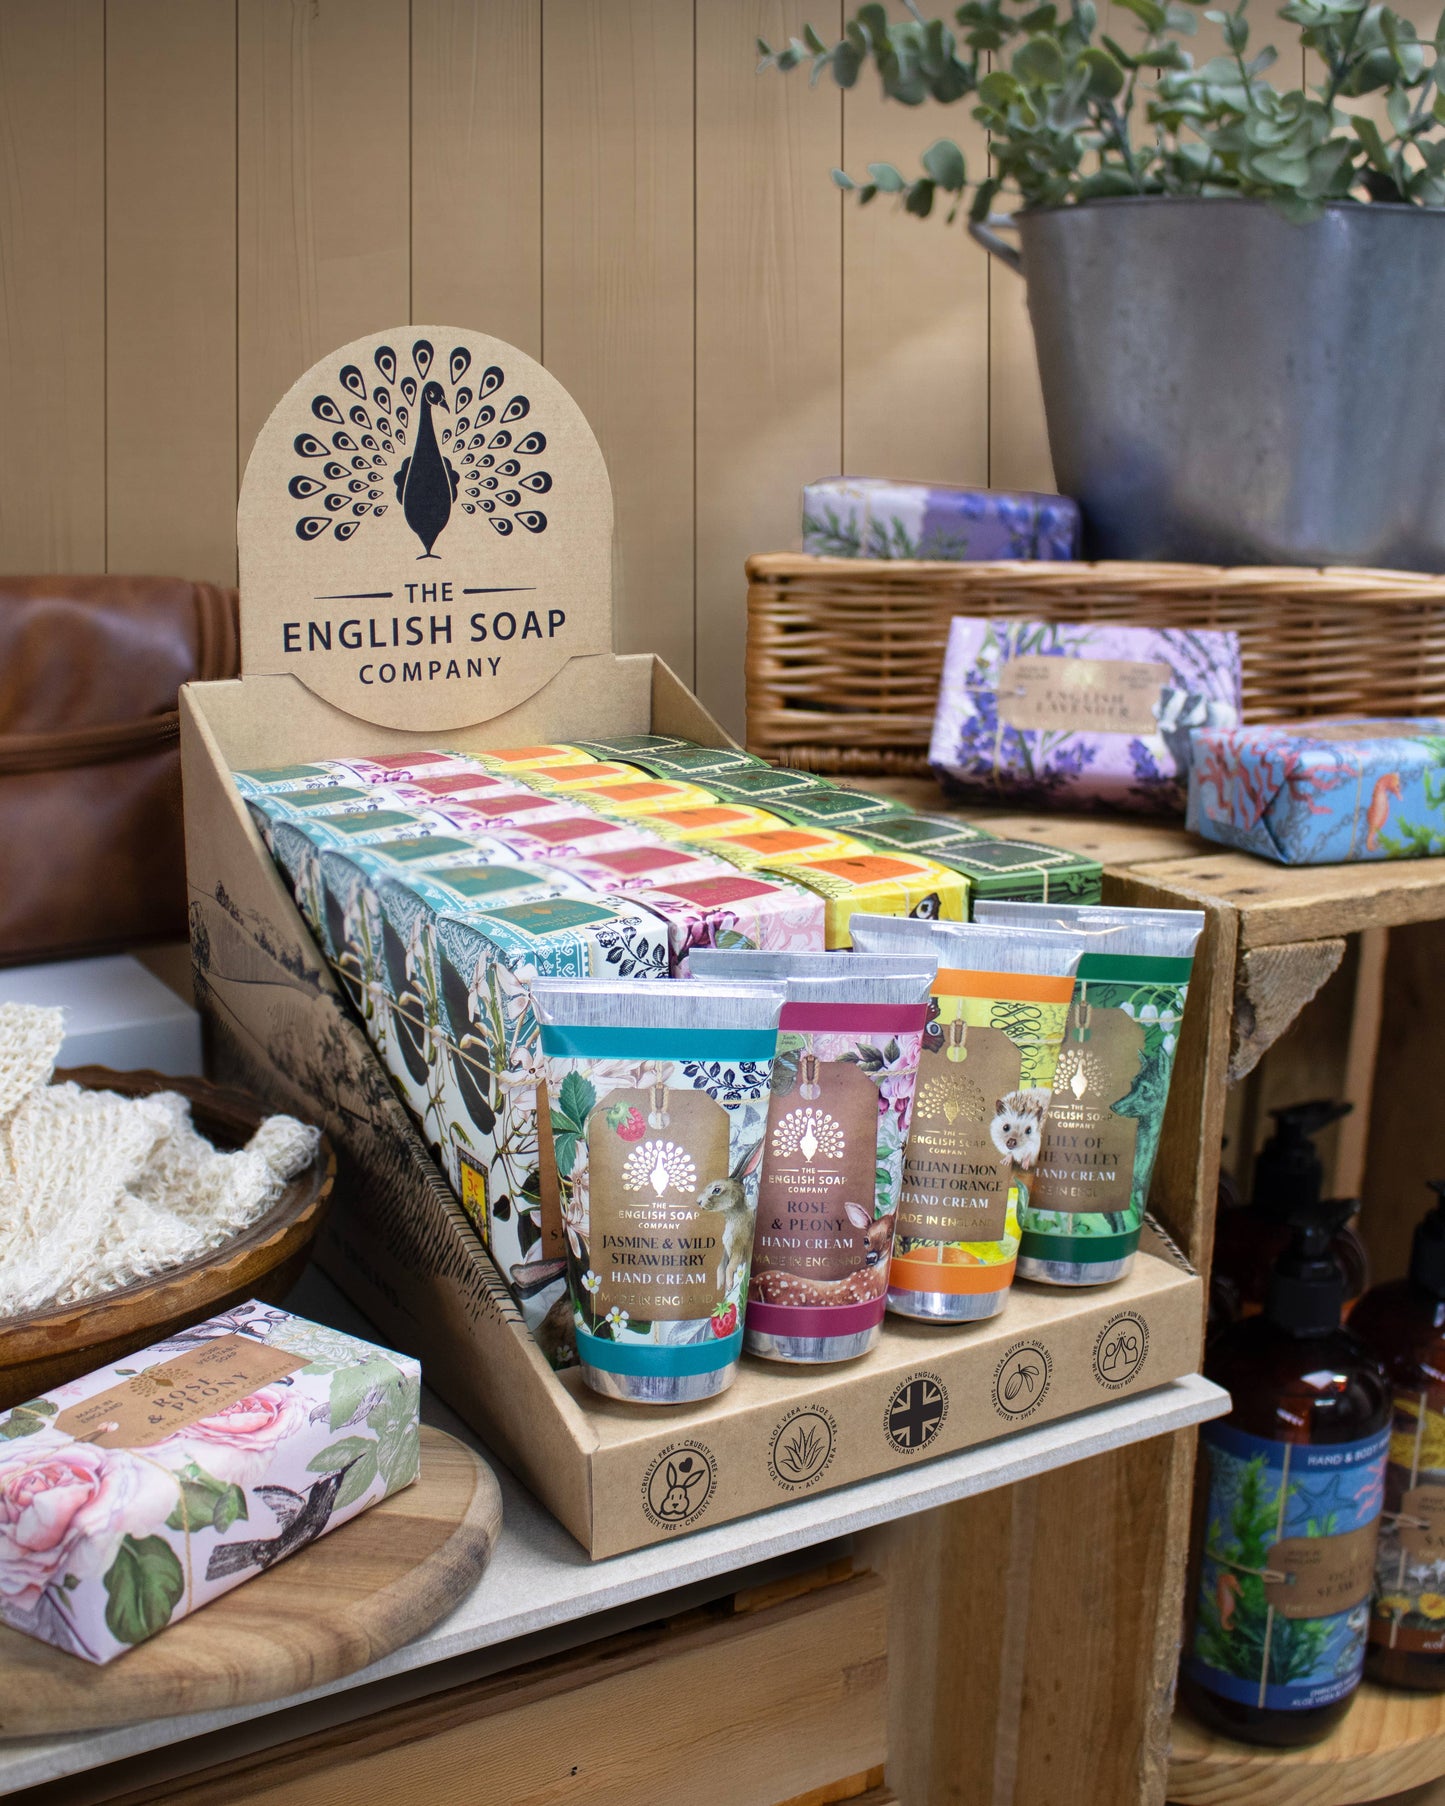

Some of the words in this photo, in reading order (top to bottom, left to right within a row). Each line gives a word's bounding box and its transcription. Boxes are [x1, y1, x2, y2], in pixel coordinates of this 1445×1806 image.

[404, 582, 454, 603] THE
[282, 614, 453, 653] ENGLISH
[470, 609, 566, 643] SOAP
[358, 657, 501, 685] COMPANY
[1046, 690, 1124, 704] ENGLISH
[1047, 1111, 1084, 1121] NGLISH
[1057, 1121, 1096, 1130] COMPANY
[911, 1135, 956, 1147] ENGLISH
[1047, 1134, 1081, 1148] LILY
[1084, 1136, 1105, 1149] OF
[928, 1147, 967, 1156] COMPANY
[1037, 1151, 1058, 1164] HE
[1064, 1152, 1121, 1166] VALLEY
[904, 1158, 950, 1174] ICILIAN
[952, 1163, 998, 1176] LEMON
[1071, 1169, 1116, 1182] CREAM
[768, 1175, 815, 1185] ENGLISH
[818, 1176, 848, 1185] SOAP
[902, 1176, 946, 1189] SWEET
[950, 1178, 1003, 1192] ORANGE
[787, 1200, 830, 1214] ROSE
[901, 1192, 939, 1205] HAND
[942, 1196, 989, 1209] CREAM
[618, 1210, 667, 1220] ENGLISH
[670, 1211, 700, 1220] SOAP
[900, 1214, 923, 1225] ADE
[926, 1215, 938, 1226] IN
[638, 1222, 681, 1230] COMPANY
[771, 1218, 783, 1230] &
[790, 1218, 844, 1232] PEONY
[602, 1234, 659, 1250] JASMINE
[662, 1237, 674, 1250] &
[677, 1236, 716, 1250] WILD
[761, 1236, 801, 1248] HAND
[805, 1237, 853, 1249] CREAM
[611, 1252, 707, 1267] STRAWBERRY
[805, 1255, 862, 1267] ENGND
[611, 1271, 652, 1284] HAND
[656, 1272, 706, 1285] CREAM
[601, 1292, 636, 1305] MDE
[655, 1295, 714, 1307] ENGLD
[993, 1359, 1005, 1378] SHEA
[1004, 1340, 1025, 1358] BUTTER
[1031, 1339, 1045, 1351] SHEA
[1043, 1349, 1053, 1373] BUTTER
[152, 1378, 214, 1408] ROSE
[888, 1382, 906, 1404] MADE
[905, 1375, 913, 1384] IN
[914, 1371, 943, 1385] ENGLAND
[147, 1414, 166, 1425] &
[171, 1371, 248, 1411] PEONY
[75, 1404, 101, 1420] MADE
[102, 1399, 113, 1407] IN
[80, 1401, 124, 1424] ENGLAND
[922, 1433, 939, 1450] MADE
[937, 1422, 945, 1431] IN
[941, 1385, 950, 1421] ENGLAND
[1020, 1407, 1037, 1421] SHEA
[768, 1423, 782, 1447] ALOE
[781, 1406, 801, 1422] VERA
[810, 1403, 829, 1416] ALOE
[828, 1414, 838, 1435] VERA
[884, 1431, 891, 1441] IN
[888, 1440, 915, 1455] ENGLAND
[684, 1439, 712, 1455] CRUELTY
[708, 1455, 718, 1473] FREE
[1307, 1454, 1342, 1466] HAND
[1345, 1452, 1352, 1464] &
[1354, 1446, 1378, 1461] BODY
[641, 1458, 658, 1494] CRUELTY
[658, 1443, 675, 1459] FREE
[767, 1461, 778, 1481] ALOE
[777, 1480, 795, 1492] VERA
[805, 1470, 825, 1489] ALOE
[685, 1500, 711, 1526] CRUELTY
[708, 1480, 718, 1499] FREE
[641, 1502, 661, 1527] CRUELTY
[661, 1523, 677, 1531] FREE
